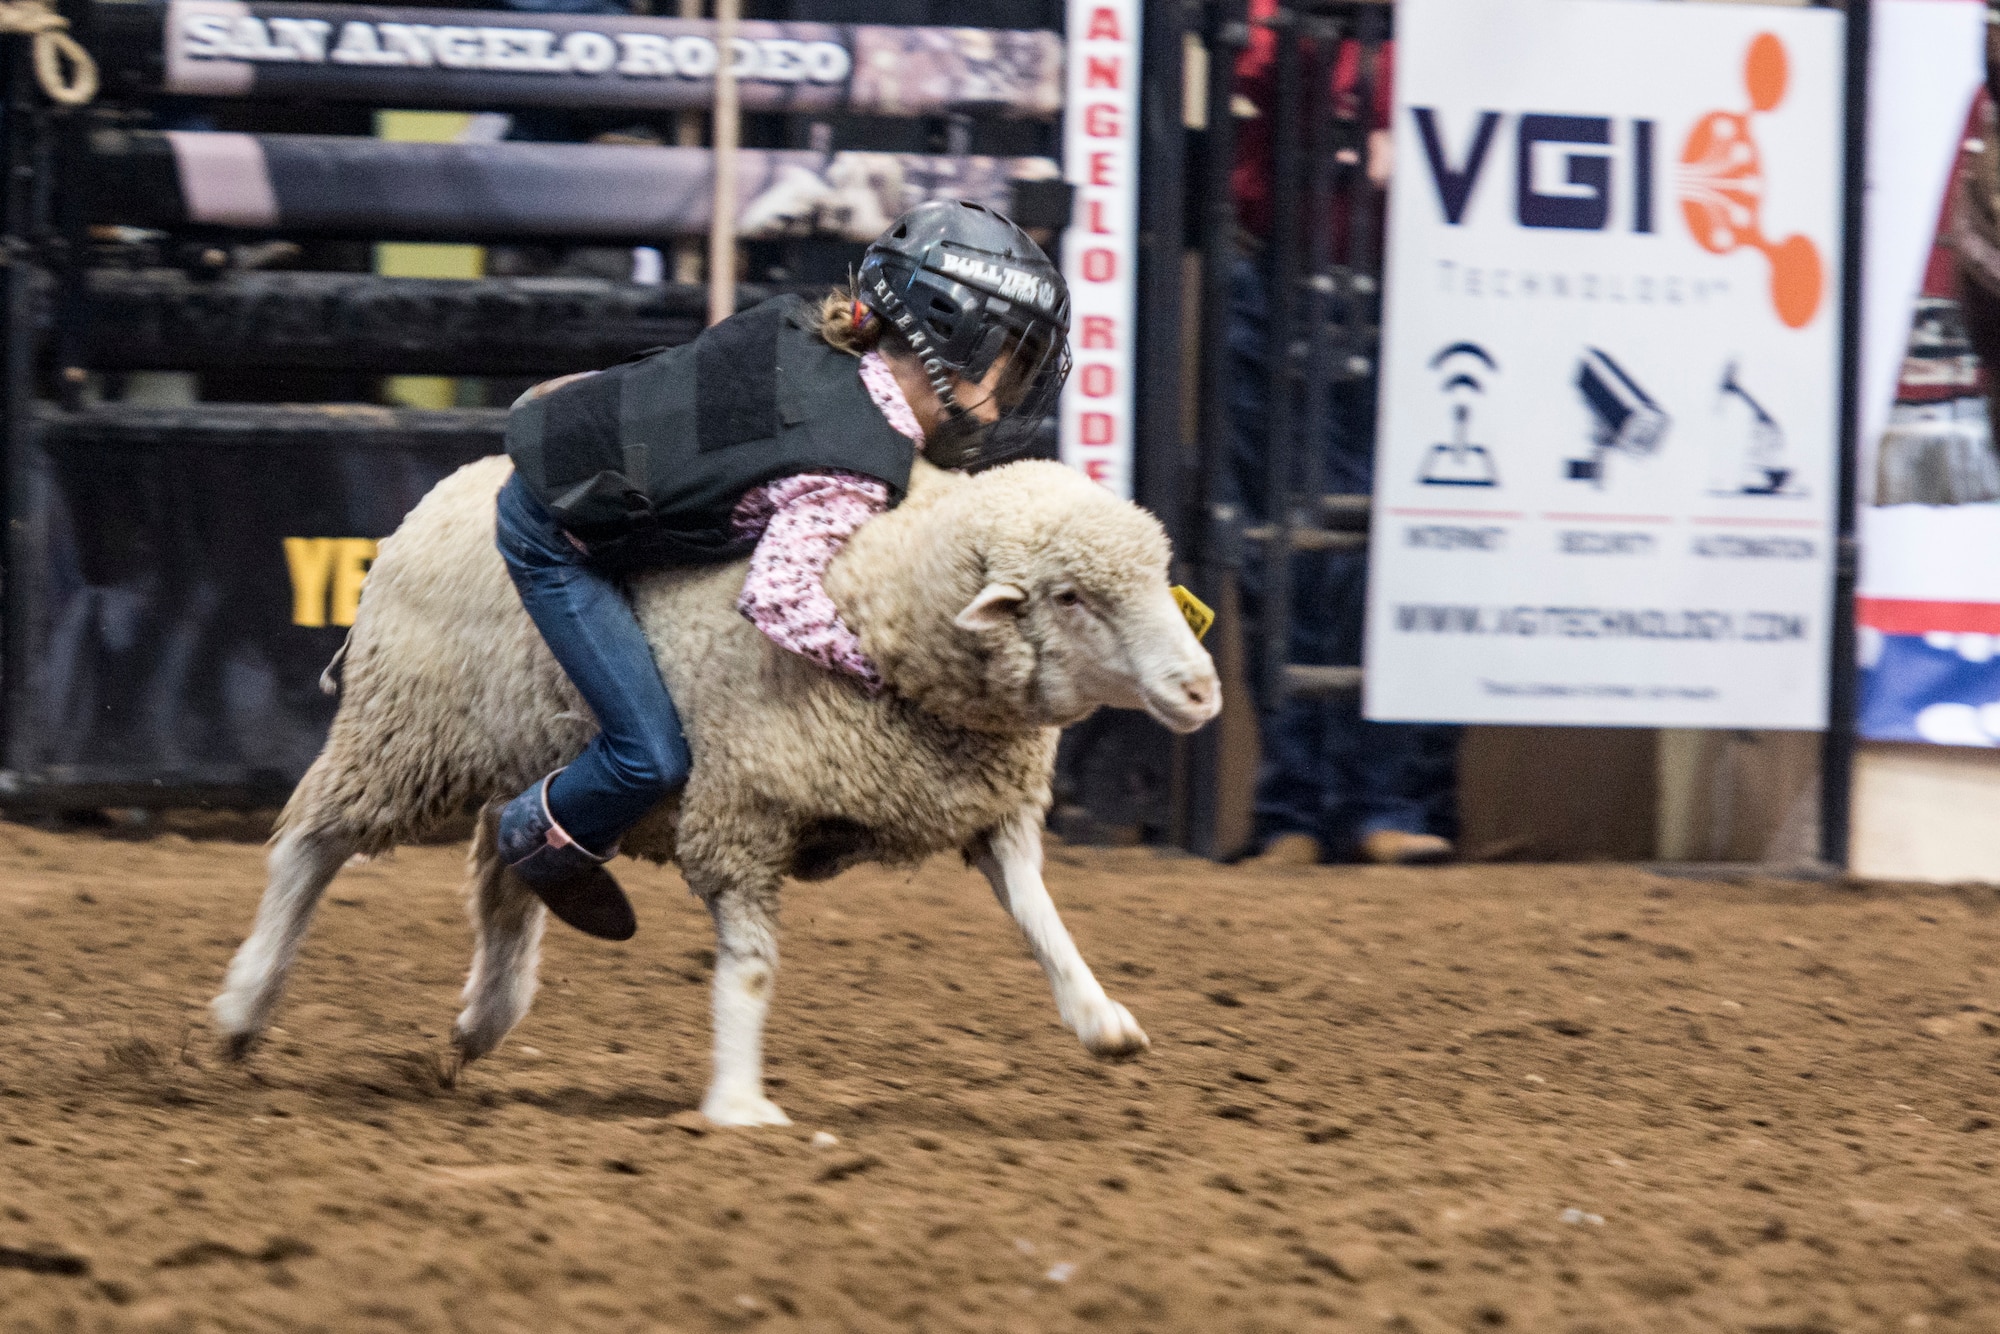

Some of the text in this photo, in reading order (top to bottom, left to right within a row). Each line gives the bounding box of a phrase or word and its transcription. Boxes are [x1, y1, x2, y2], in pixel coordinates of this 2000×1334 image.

[185, 15, 849, 83] SAN ANGELO RODEO
[1082, 7, 1121, 283] ANGELO
[1411, 107, 1656, 234] VGI
[940, 252, 1003, 288] BULL
